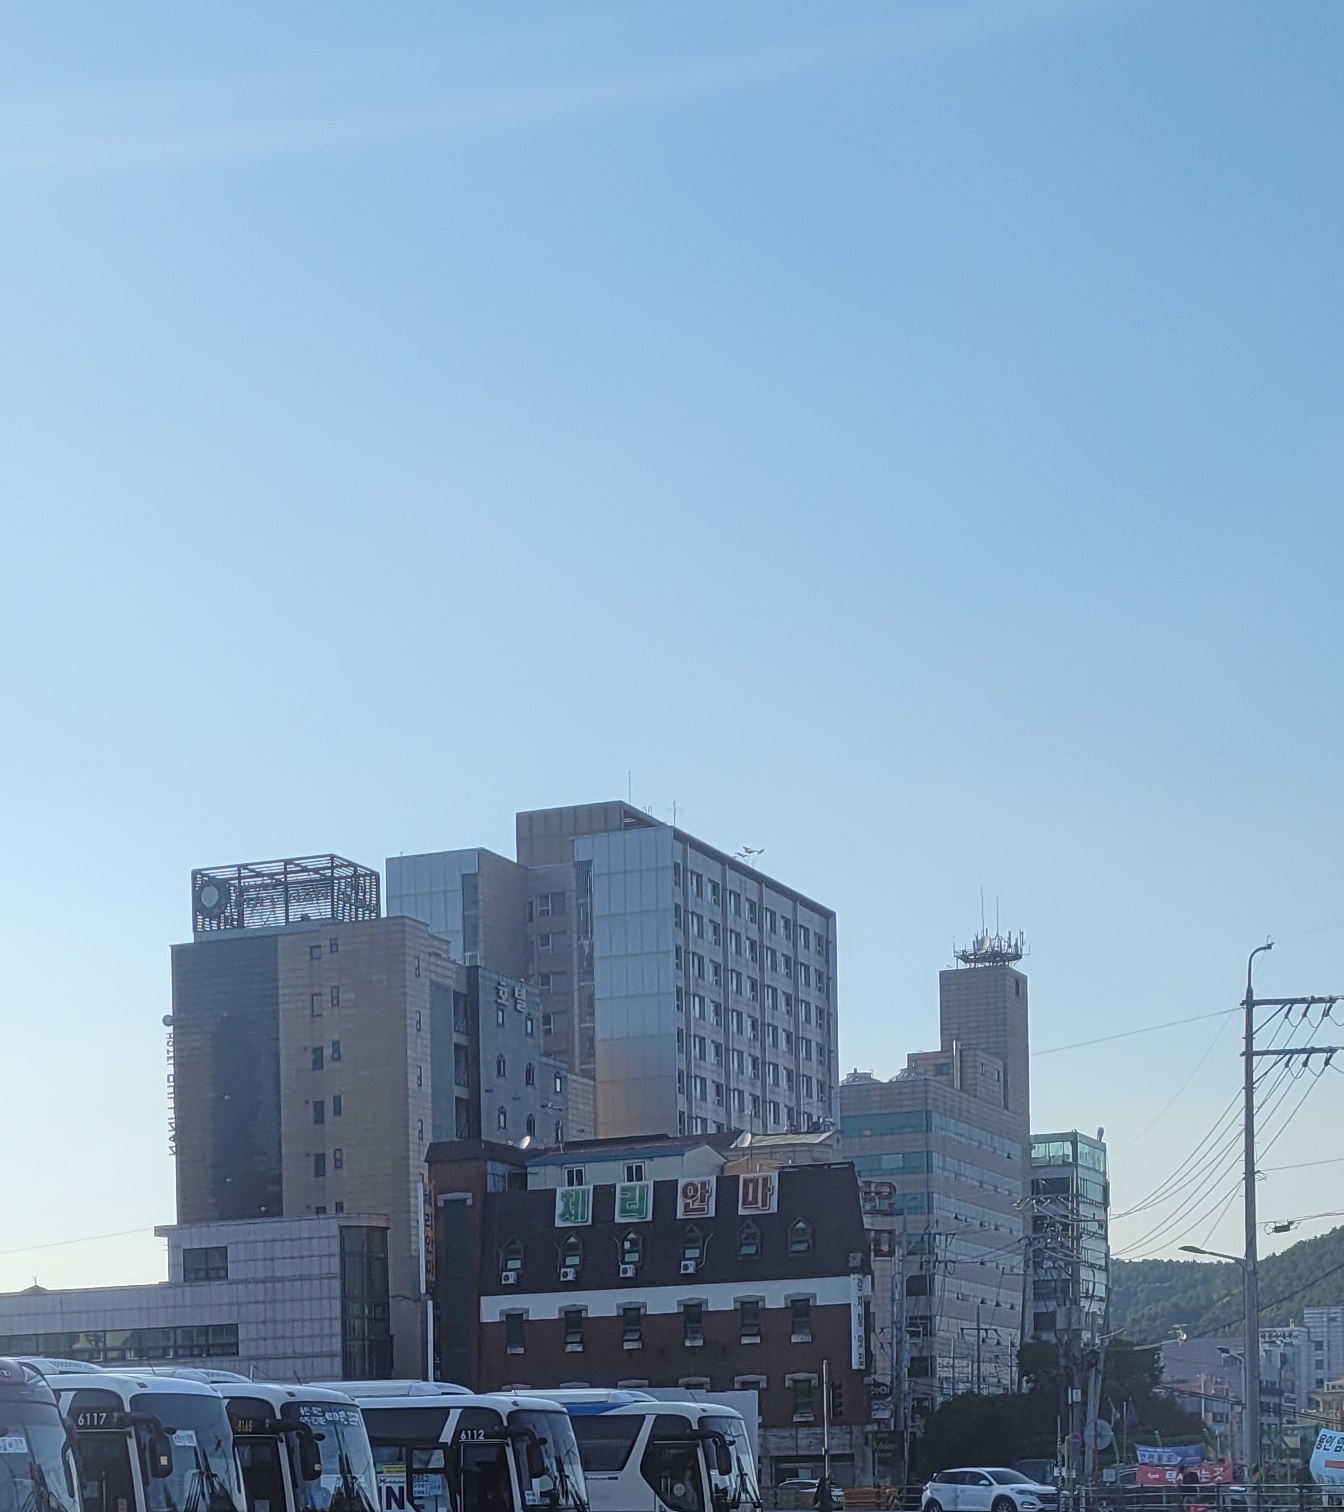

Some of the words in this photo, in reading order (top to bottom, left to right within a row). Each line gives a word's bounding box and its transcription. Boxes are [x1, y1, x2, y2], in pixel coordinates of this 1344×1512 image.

[77, 1412, 107, 1426] 6117
[460, 1429, 485, 1440] 6112
[1316, 1433, 1336, 1451] 용인
